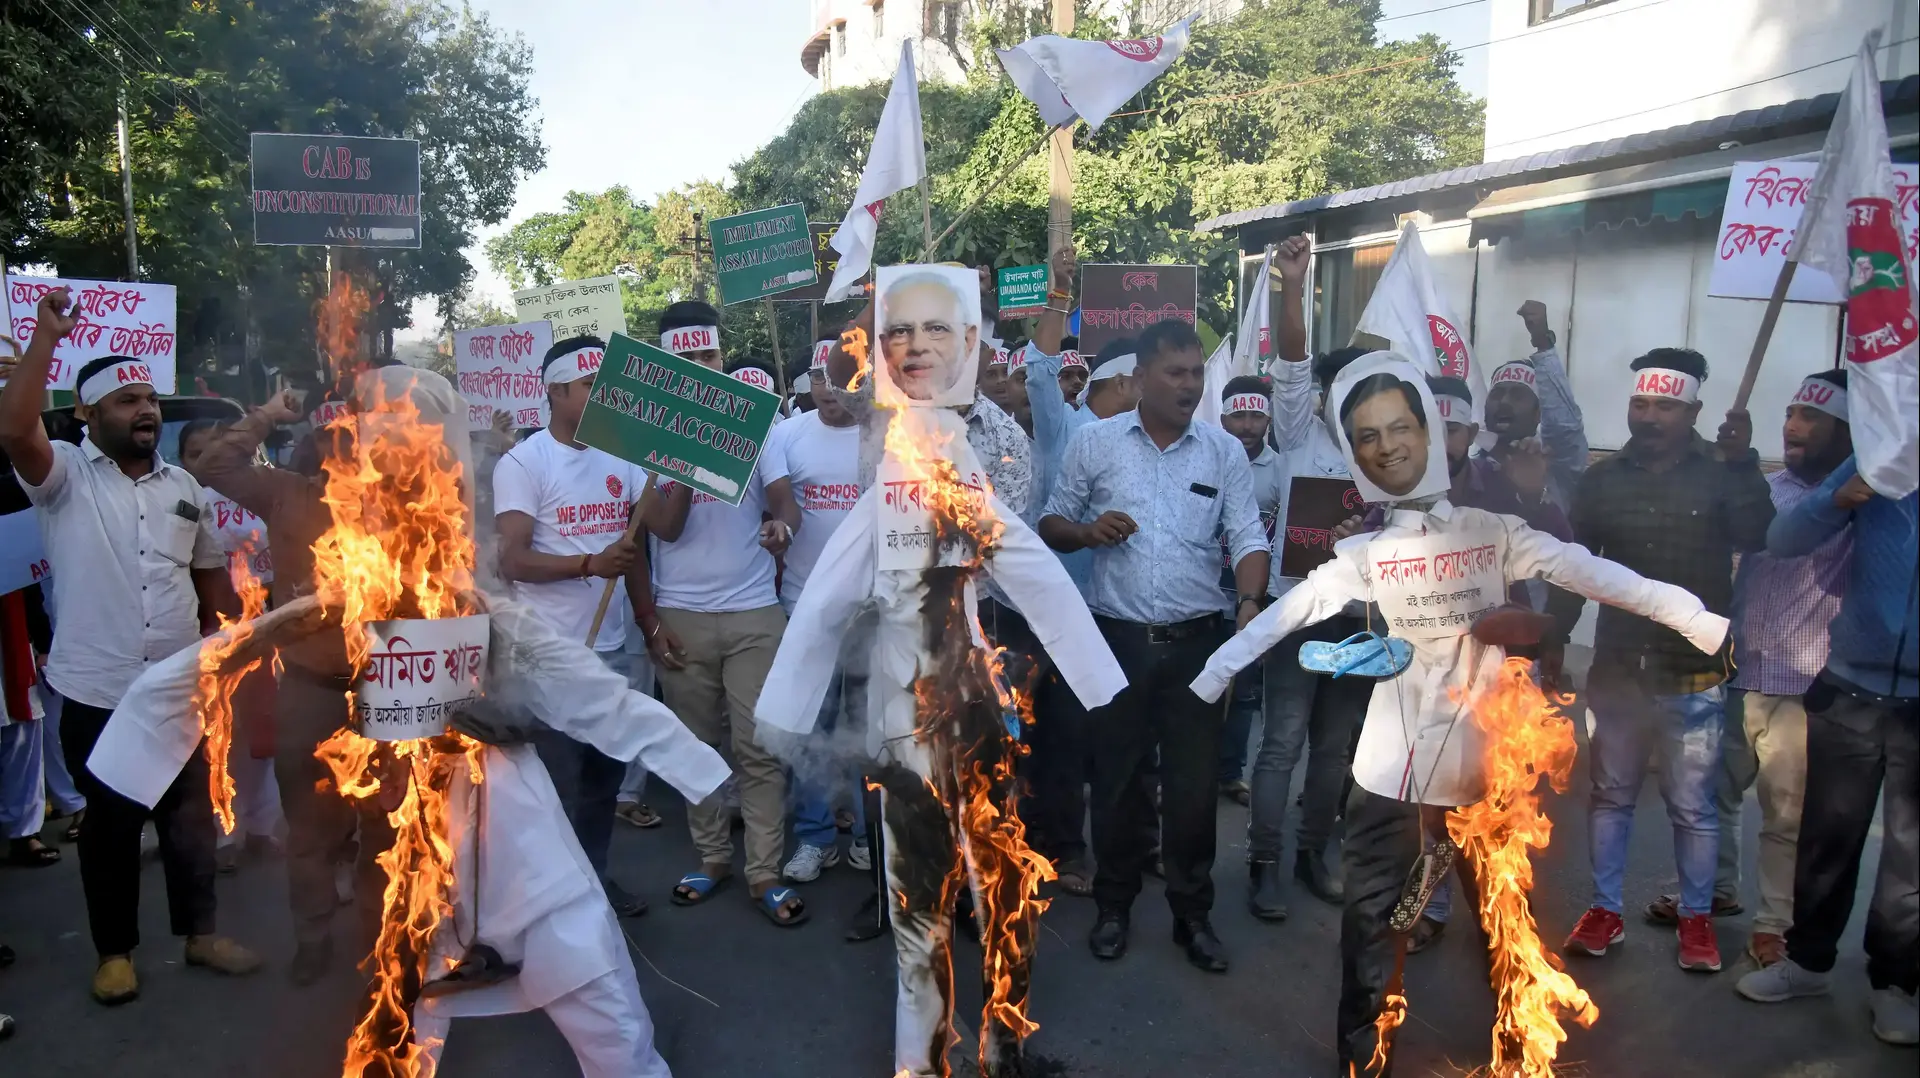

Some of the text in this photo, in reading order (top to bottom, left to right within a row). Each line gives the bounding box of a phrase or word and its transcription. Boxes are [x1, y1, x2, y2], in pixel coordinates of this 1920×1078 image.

[302, 144, 371, 180] CAB IS
[253, 189, 420, 217] UNCONSTITUTIONAL
[723, 215, 797, 246] IMPLEMENT
[718, 247, 761, 274] ASSAM
[761, 238, 812, 264] ACCORD
[1000, 281, 1048, 296] UMANANDA GHAT
[1121, 271, 1160, 292] কেব
[515, 295, 542, 308] অসম
[567, 304, 590, 318] কেব
[469, 335, 497, 360] অসম
[671, 330, 712, 352] AASU
[621, 352, 757, 423] IMPLEMENT
[1635, 373, 1686, 397] AASU
[1232, 396, 1265, 411] AASU
[590, 382, 759, 463] ASSAM ACCORD
[803, 483, 859, 500] WE OPPOS
[556, 505, 577, 525] WE
[579, 500, 617, 523] OPPOSE
[571, 525, 600, 537] GUWAHATI
[363, 635, 438, 691] অমিত
